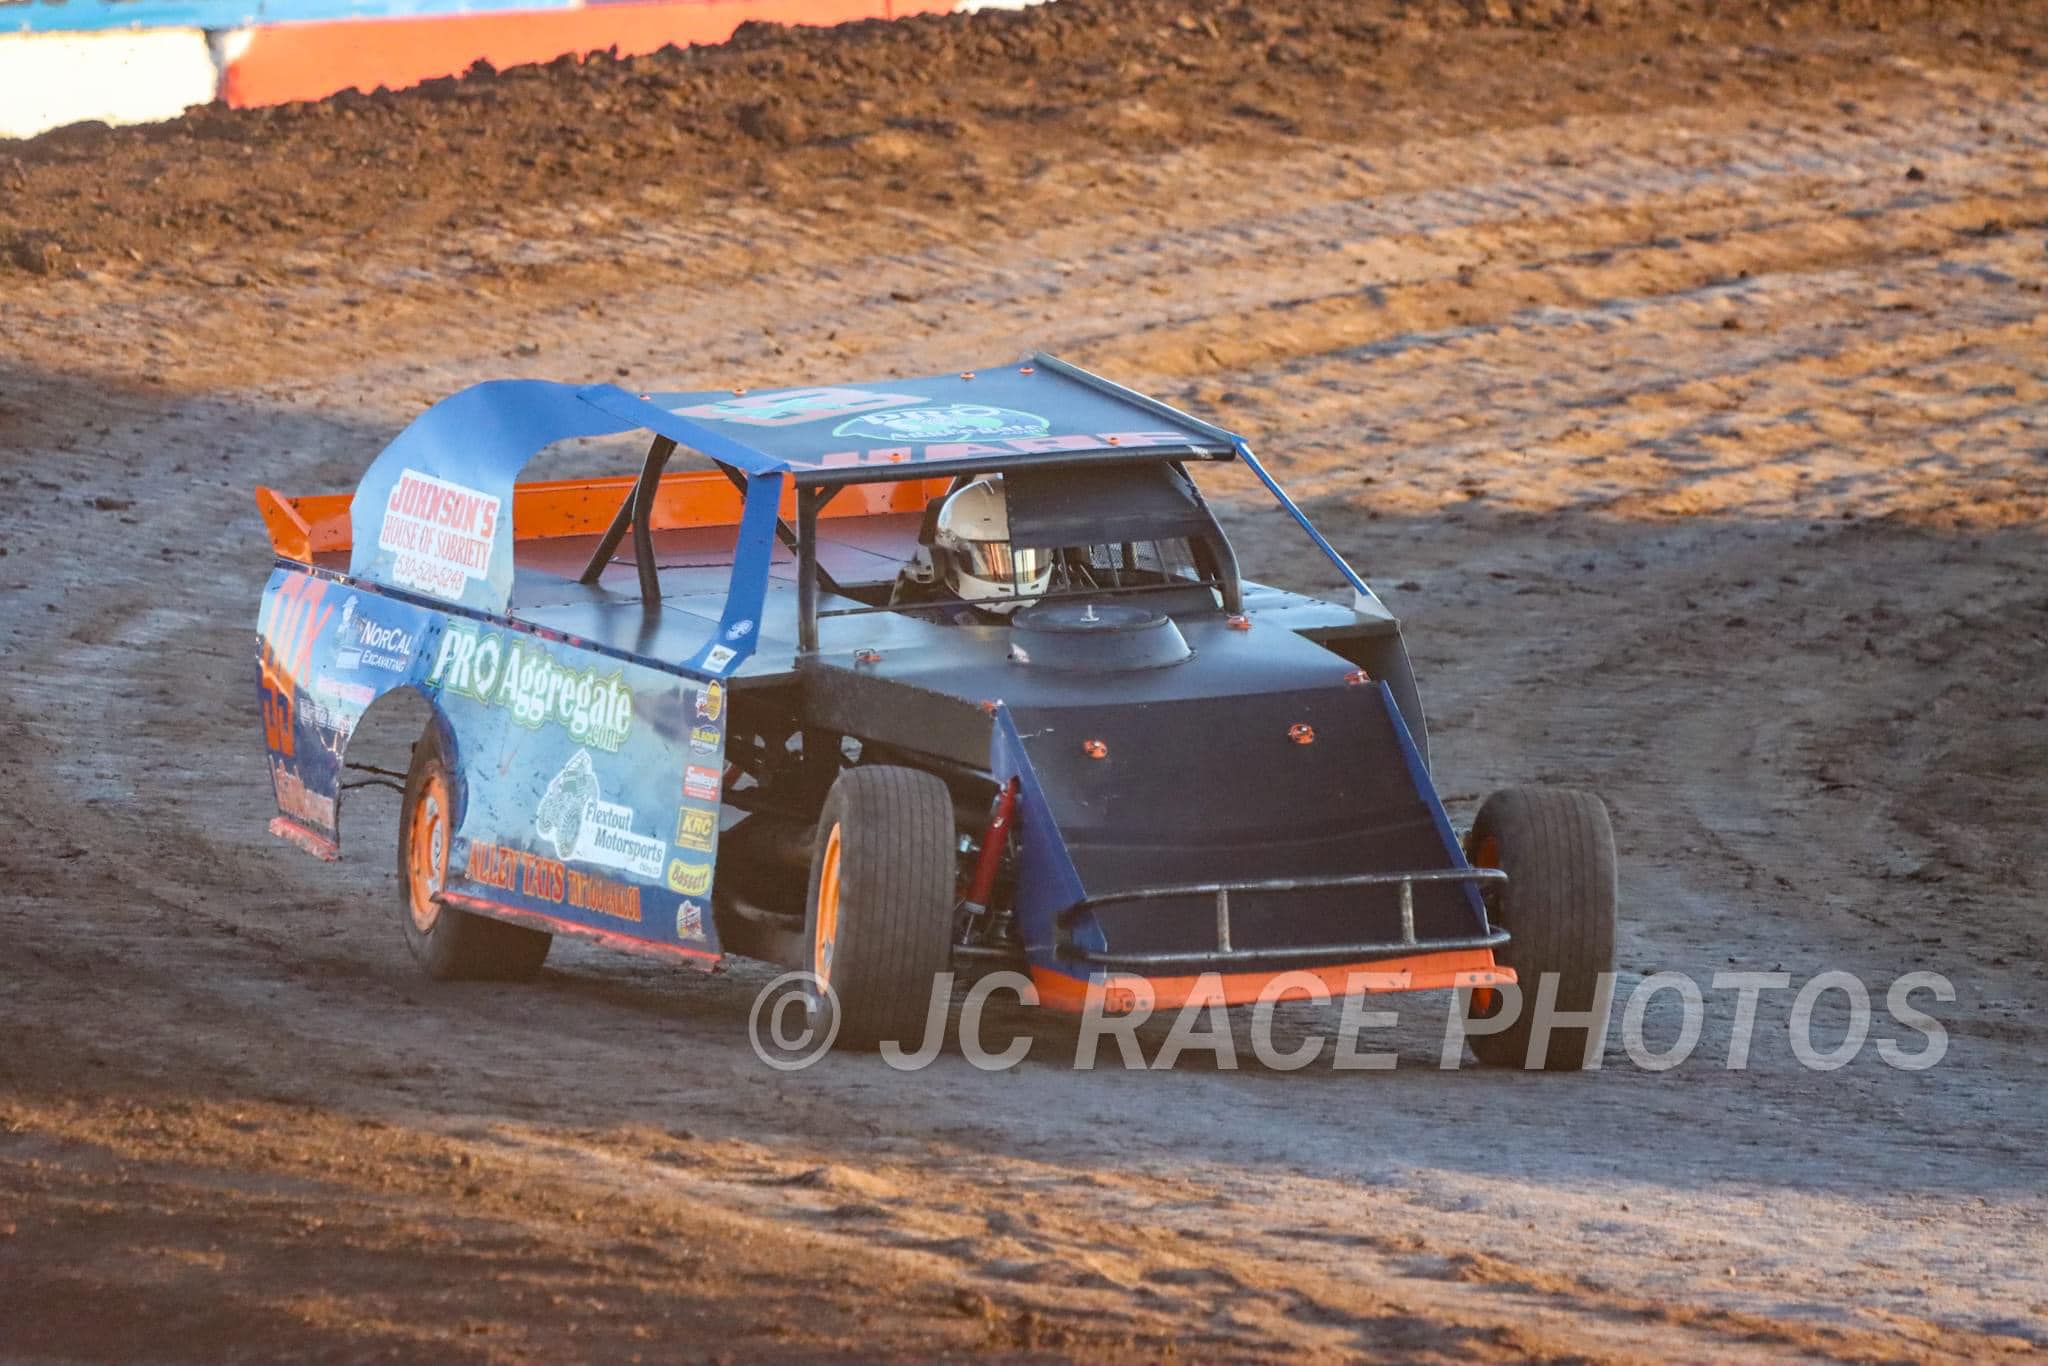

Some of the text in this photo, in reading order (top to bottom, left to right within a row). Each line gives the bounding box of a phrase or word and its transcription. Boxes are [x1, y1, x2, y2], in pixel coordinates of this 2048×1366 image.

[390, 476, 497, 538] JOHNSON'S
[381, 514, 491, 571] HOUSE OF SOBRIETY
[430, 629, 632, 735] PRO Aggregate
[584, 801, 631, 831] Flextout
[594, 826, 664, 862] Motorsports
[682, 814, 713, 836] KRC
[468, 840, 520, 892] ALLEY
[521, 852, 565, 904] TATS
